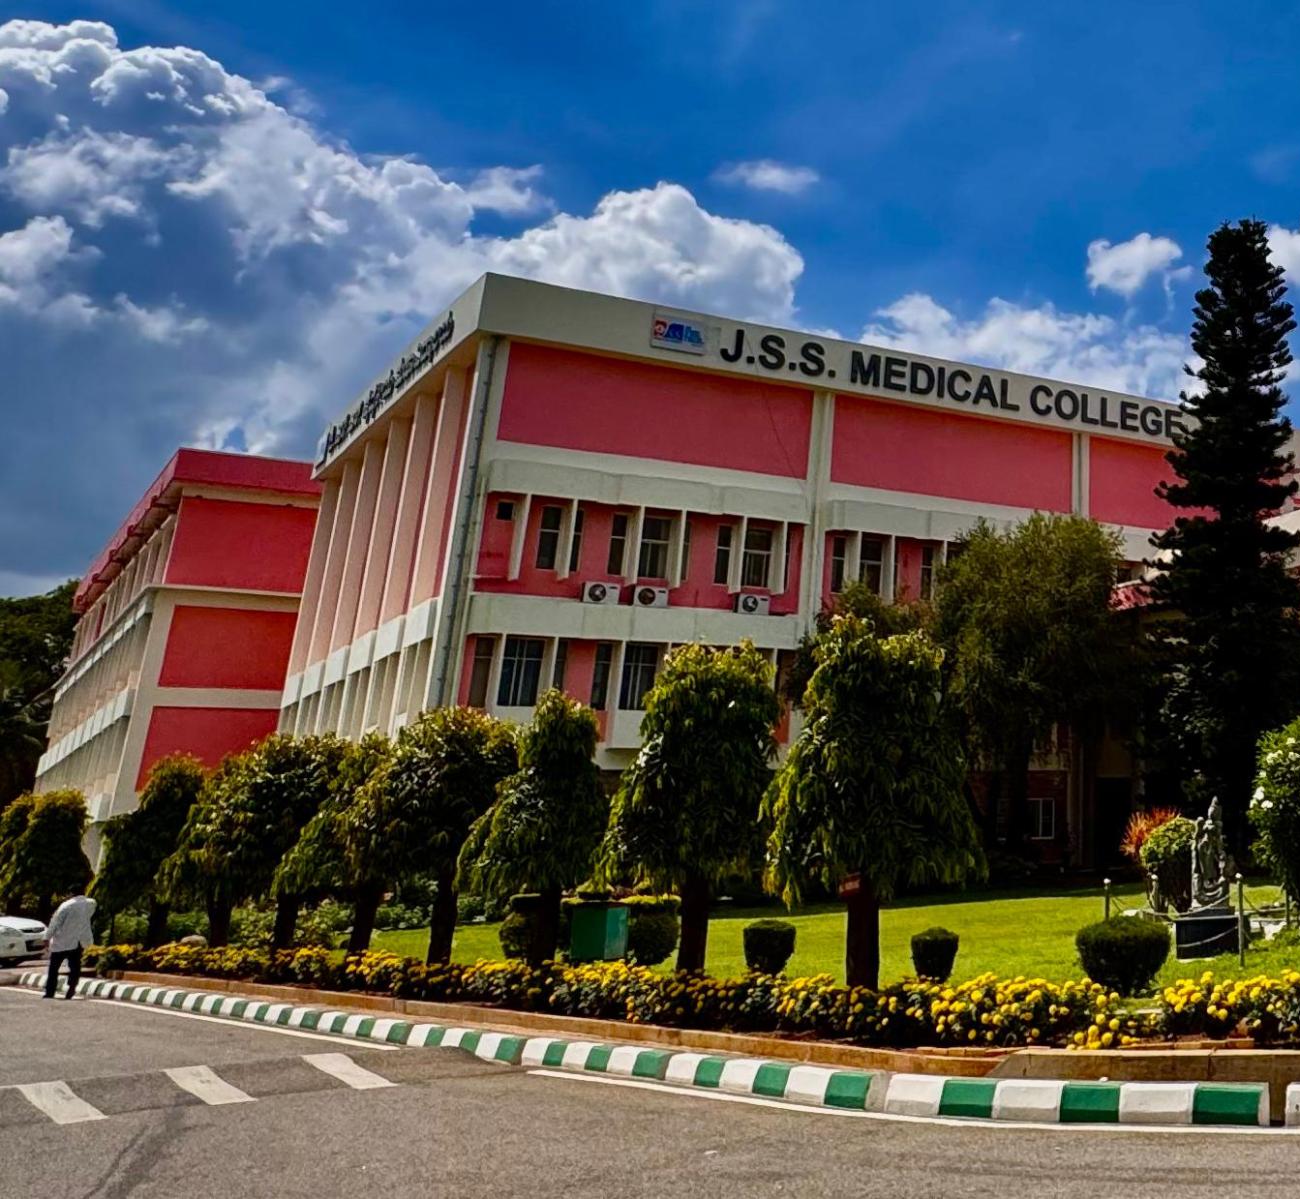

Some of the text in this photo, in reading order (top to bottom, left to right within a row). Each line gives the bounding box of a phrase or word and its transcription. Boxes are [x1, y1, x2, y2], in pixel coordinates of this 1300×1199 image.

[720, 330, 836, 378] J.S.S.
[851, 350, 1020, 411] MEDICAL
[1030, 386, 1184, 439] COLLEGE
